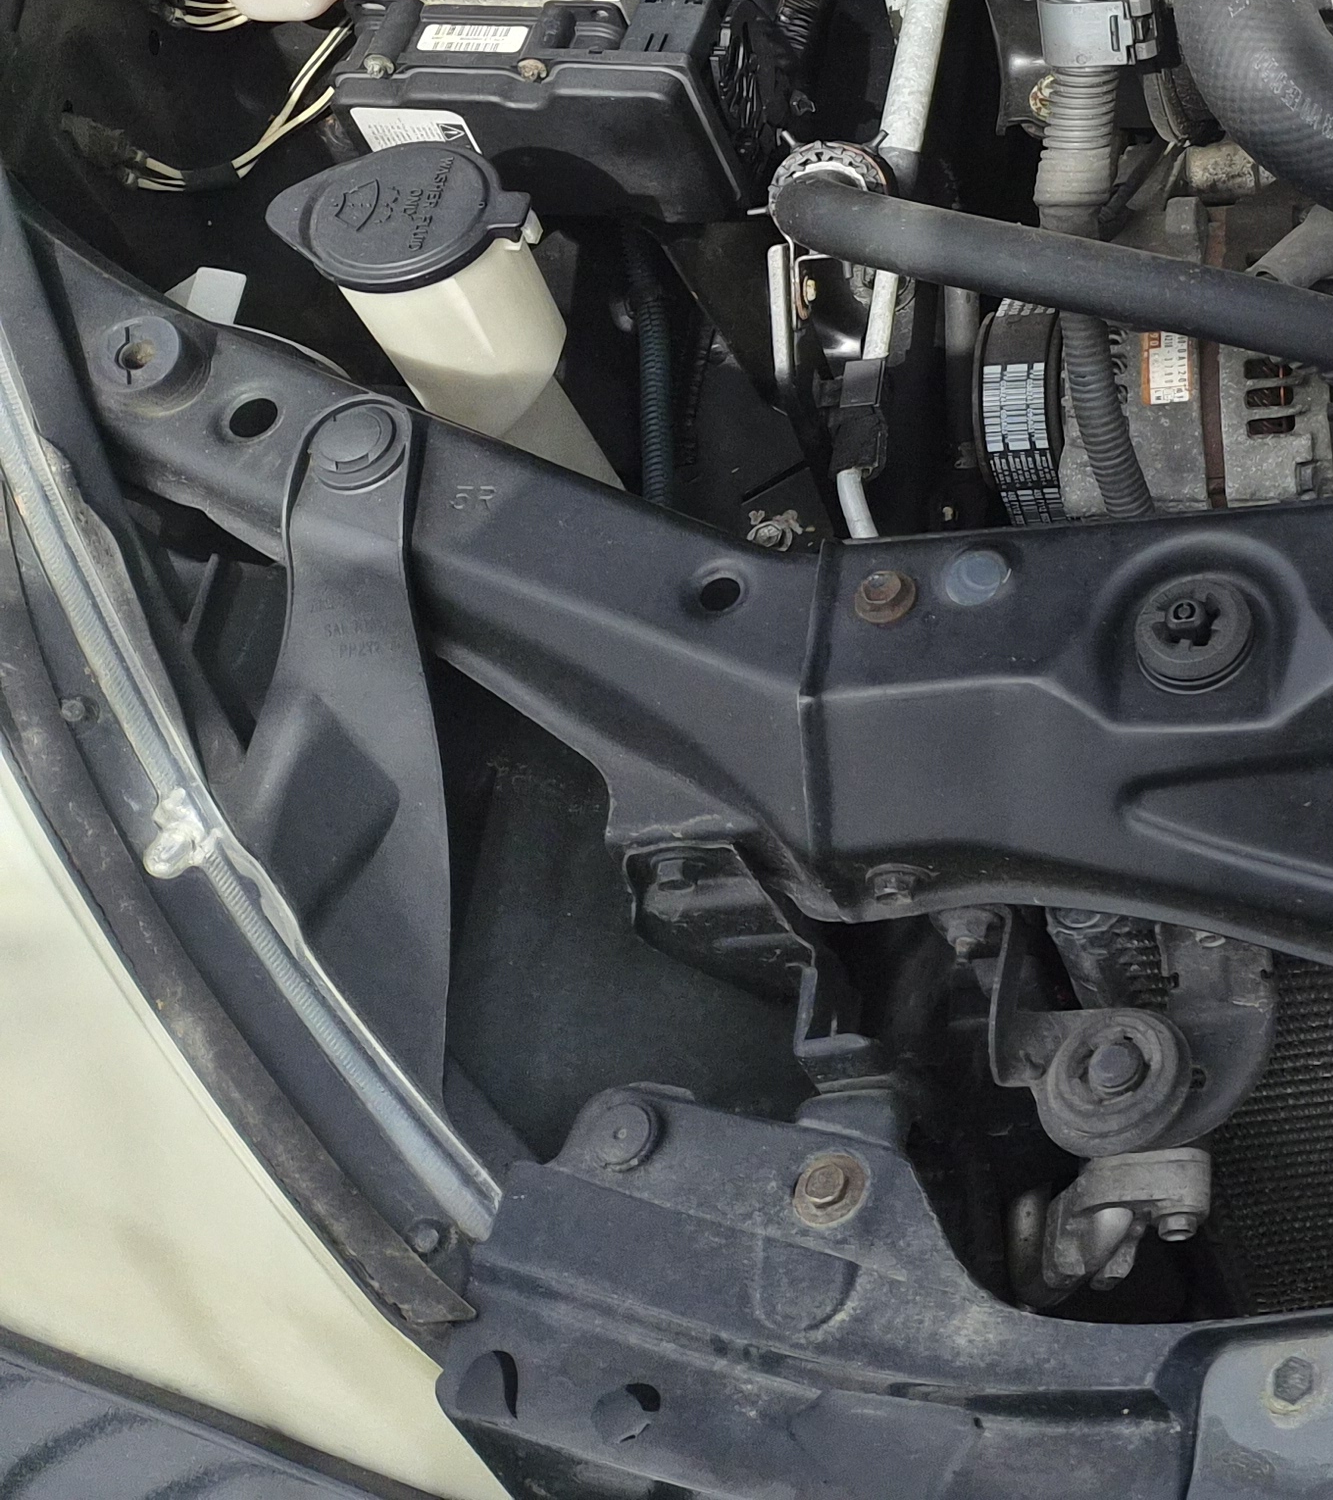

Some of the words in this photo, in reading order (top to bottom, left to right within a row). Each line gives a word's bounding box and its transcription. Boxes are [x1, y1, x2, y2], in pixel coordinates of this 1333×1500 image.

[423, 156, 454, 211] WASHER
[403, 188, 424, 222] ONLY
[408, 212, 435, 253] FLUID
